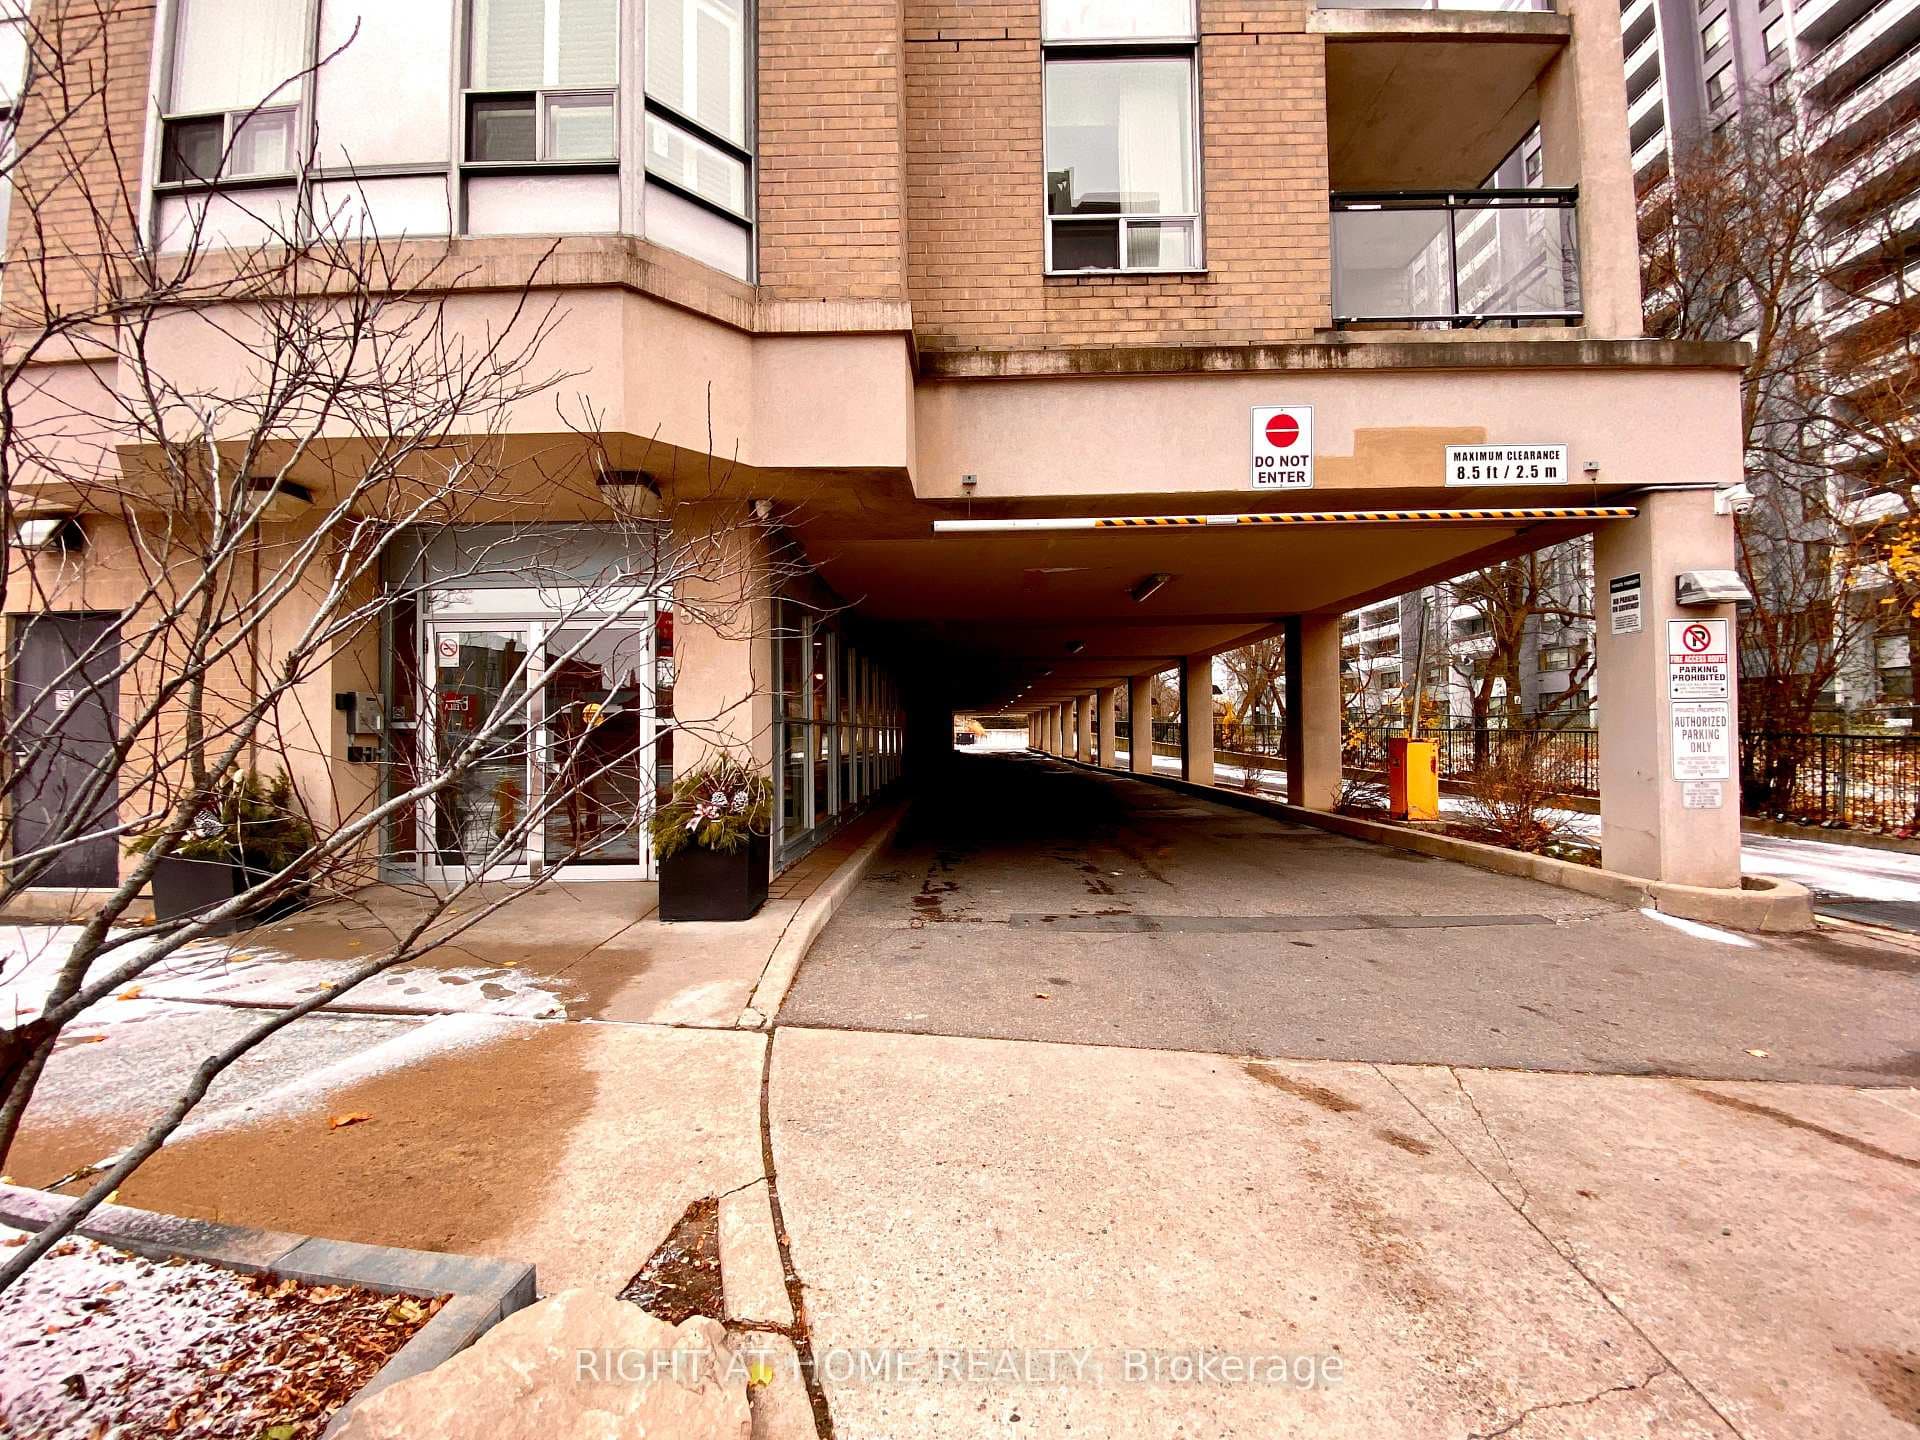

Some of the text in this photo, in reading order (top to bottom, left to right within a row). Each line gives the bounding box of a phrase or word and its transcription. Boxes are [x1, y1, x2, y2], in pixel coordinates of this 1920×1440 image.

[1255, 455, 1309, 468] DO NOT
[1453, 450, 1560, 462] MAXIMUM CLEARANCE
[1258, 471, 1306, 484] ENTER
[1457, 464, 1557, 480] 8.5 ft / 2.5 m
[1679, 666, 1719, 674] PARKING
[1672, 673, 1726, 682] PROHIBITED
[1674, 716, 1727, 728] AUTHORIZED
[1682, 729, 1720, 740] PARKING
[1690, 742, 1712, 753] ONLY
